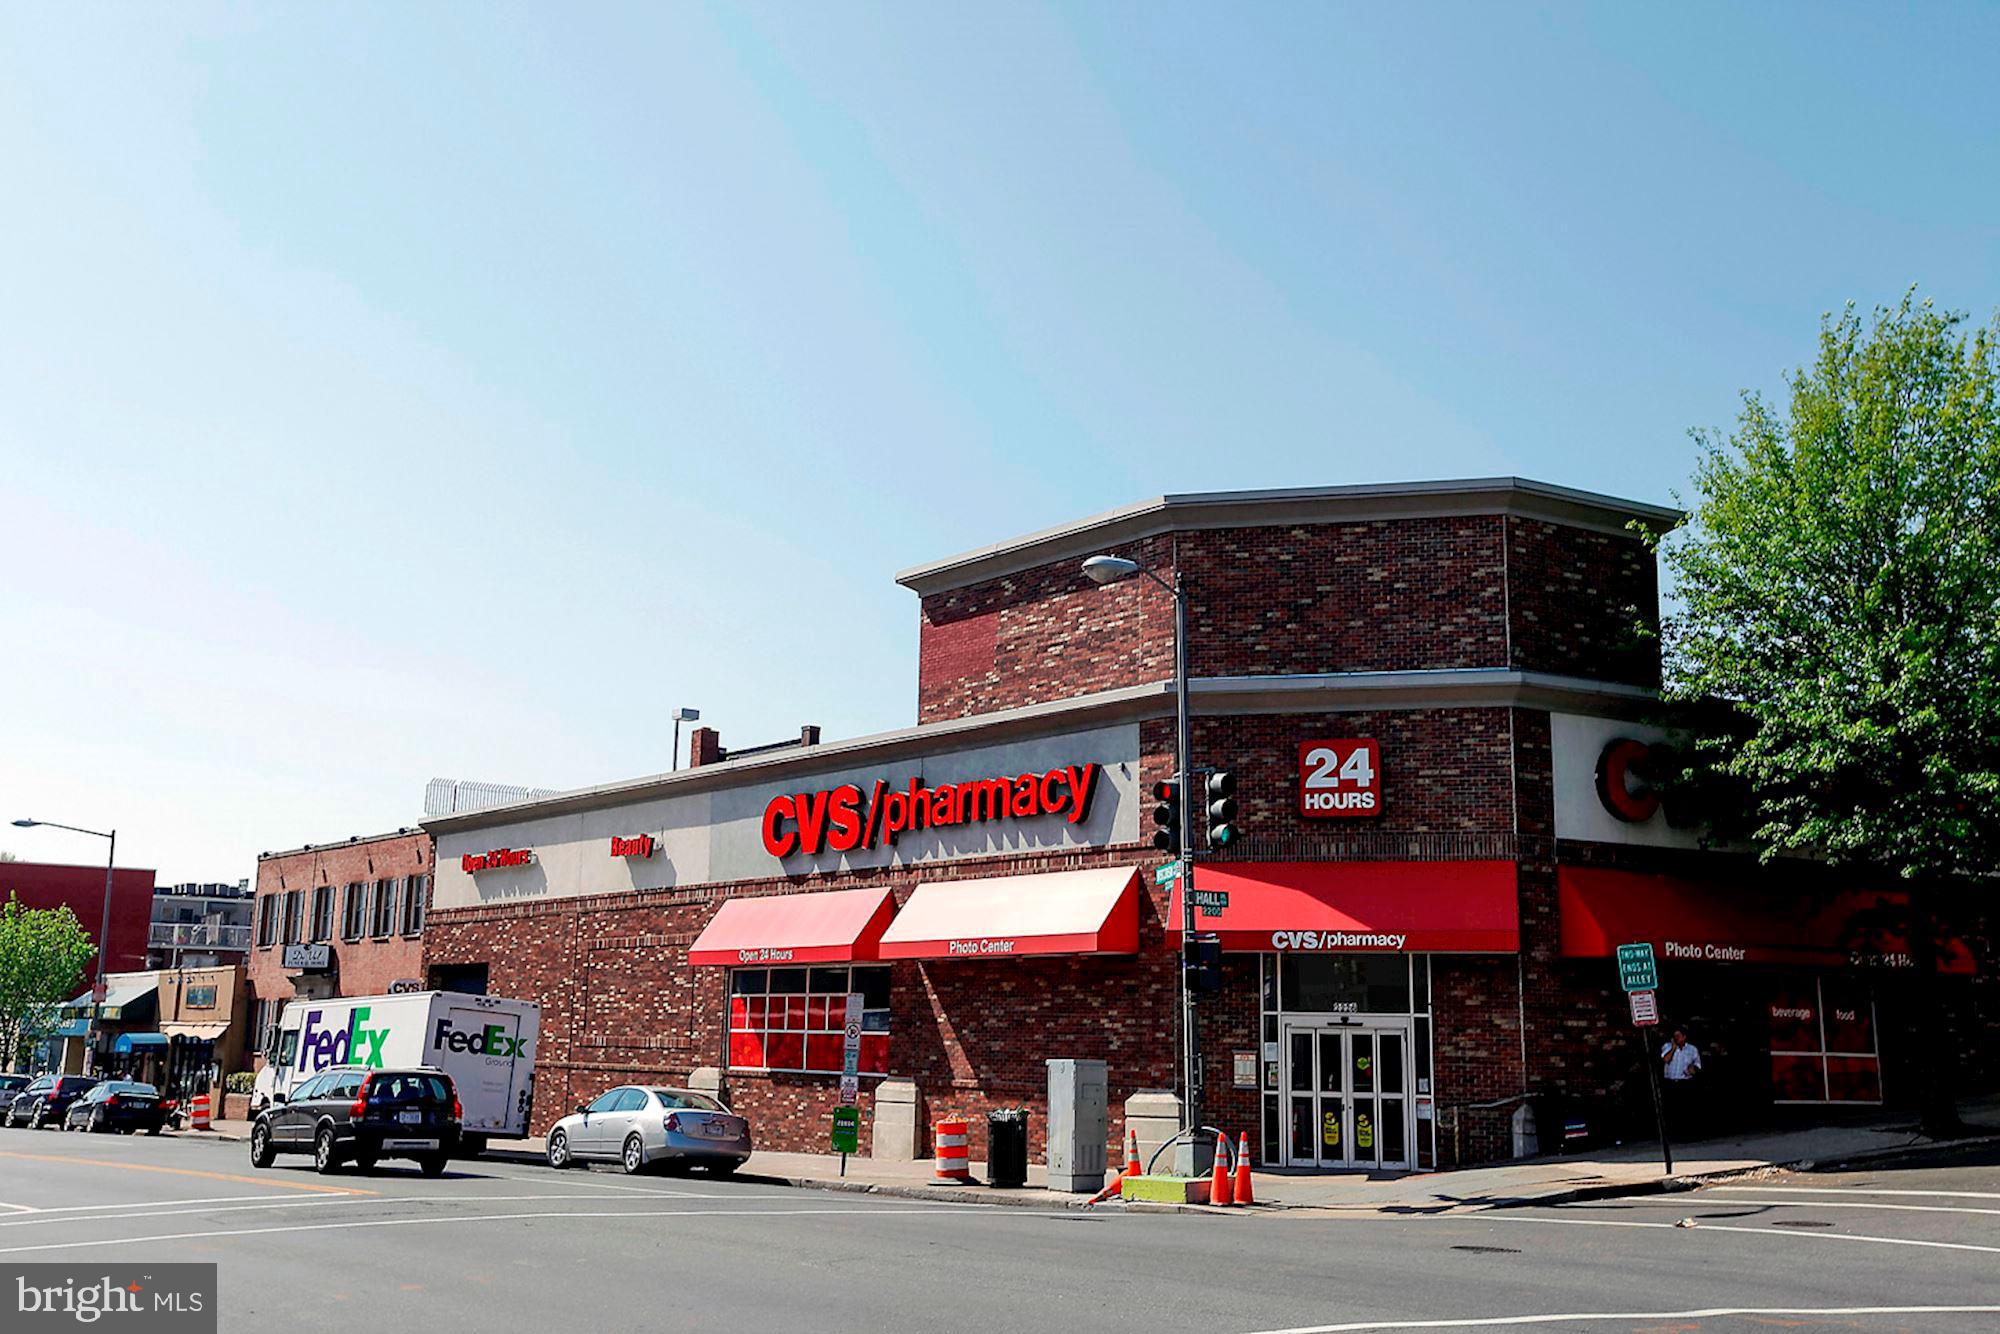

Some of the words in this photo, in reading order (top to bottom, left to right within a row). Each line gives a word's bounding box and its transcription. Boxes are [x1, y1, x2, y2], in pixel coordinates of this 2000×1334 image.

[1305, 748, 1375, 788] 24
[762, 763, 1100, 857] CVS/pharmacy
[1305, 792, 1375, 810] HOURS
[611, 834, 654, 858] Beauty
[1195, 891, 1220, 906] HALL
[949, 940, 979, 954] Photo
[980, 939, 1015, 953] Center
[1272, 931, 1406, 949] CVS/pharmacy
[739, 949, 758, 964] Open
[760, 948, 769, 960] 24
[770, 948, 793, 960] Hours
[1665, 941, 1702, 958] Photo
[1705, 943, 1746, 960] Center
[393, 982, 420, 994] CVS
[1626, 974, 1652, 986] ALLEY
[1771, 1005, 1811, 1021] beverage
[299, 1006, 391, 1072] FedEx
[434, 1018, 528, 1058] FedEx
